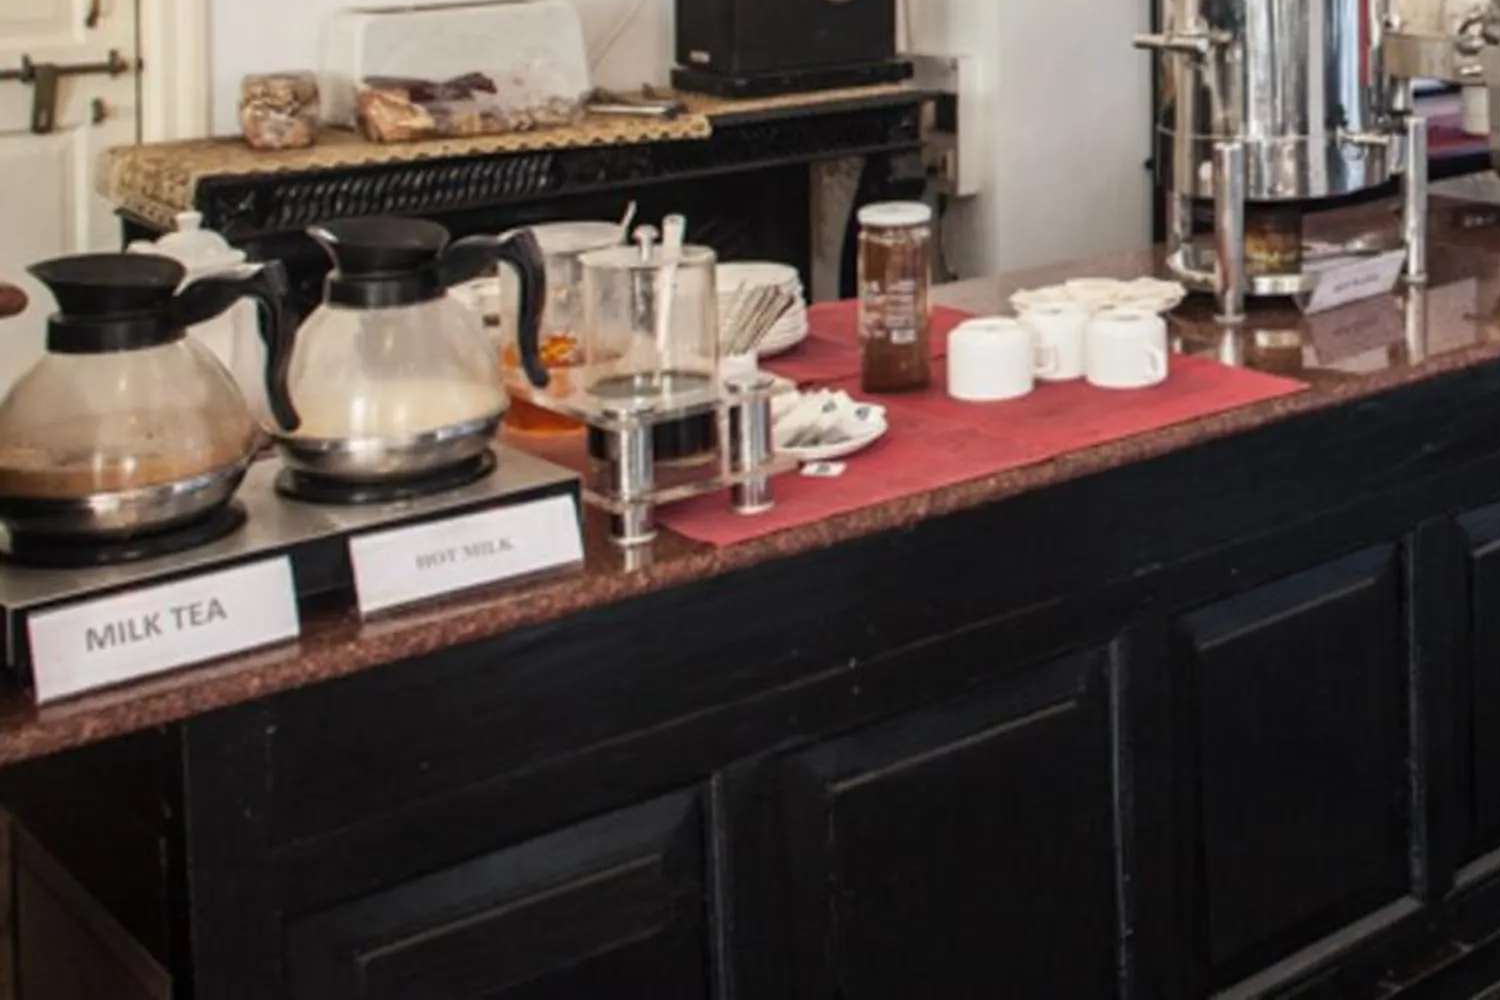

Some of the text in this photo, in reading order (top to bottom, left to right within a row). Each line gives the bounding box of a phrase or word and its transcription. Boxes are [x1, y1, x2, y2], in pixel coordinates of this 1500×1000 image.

[416, 538, 514, 570] HOT MILK
[84, 597, 228, 653] MILK TEA
